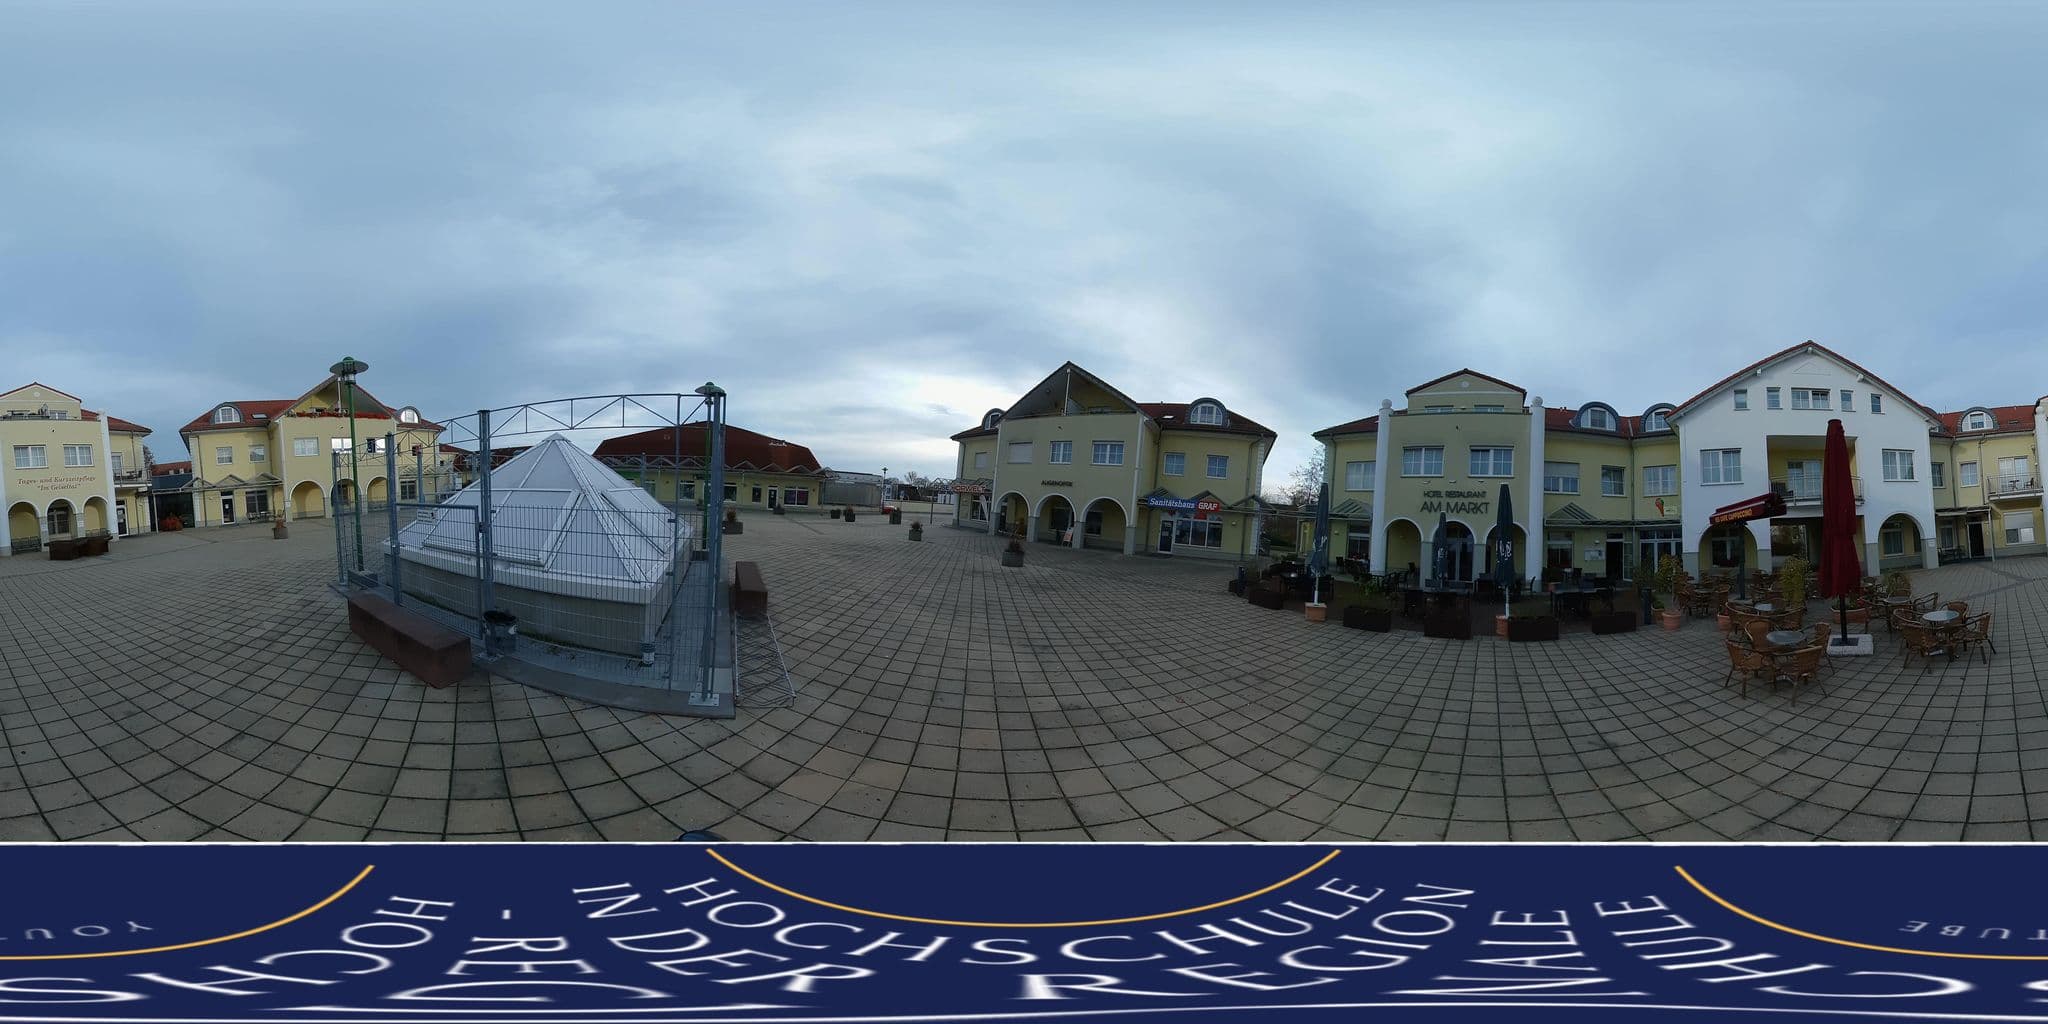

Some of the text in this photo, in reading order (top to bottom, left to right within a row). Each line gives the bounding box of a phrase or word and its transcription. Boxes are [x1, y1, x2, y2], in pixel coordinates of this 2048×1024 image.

[1423, 490, 1487, 498] HOTEL RESTAURANT
[1149, 497, 1218, 511] Sanitätshaus GRAF
[1420, 501, 1490, 514] AM MARKT
